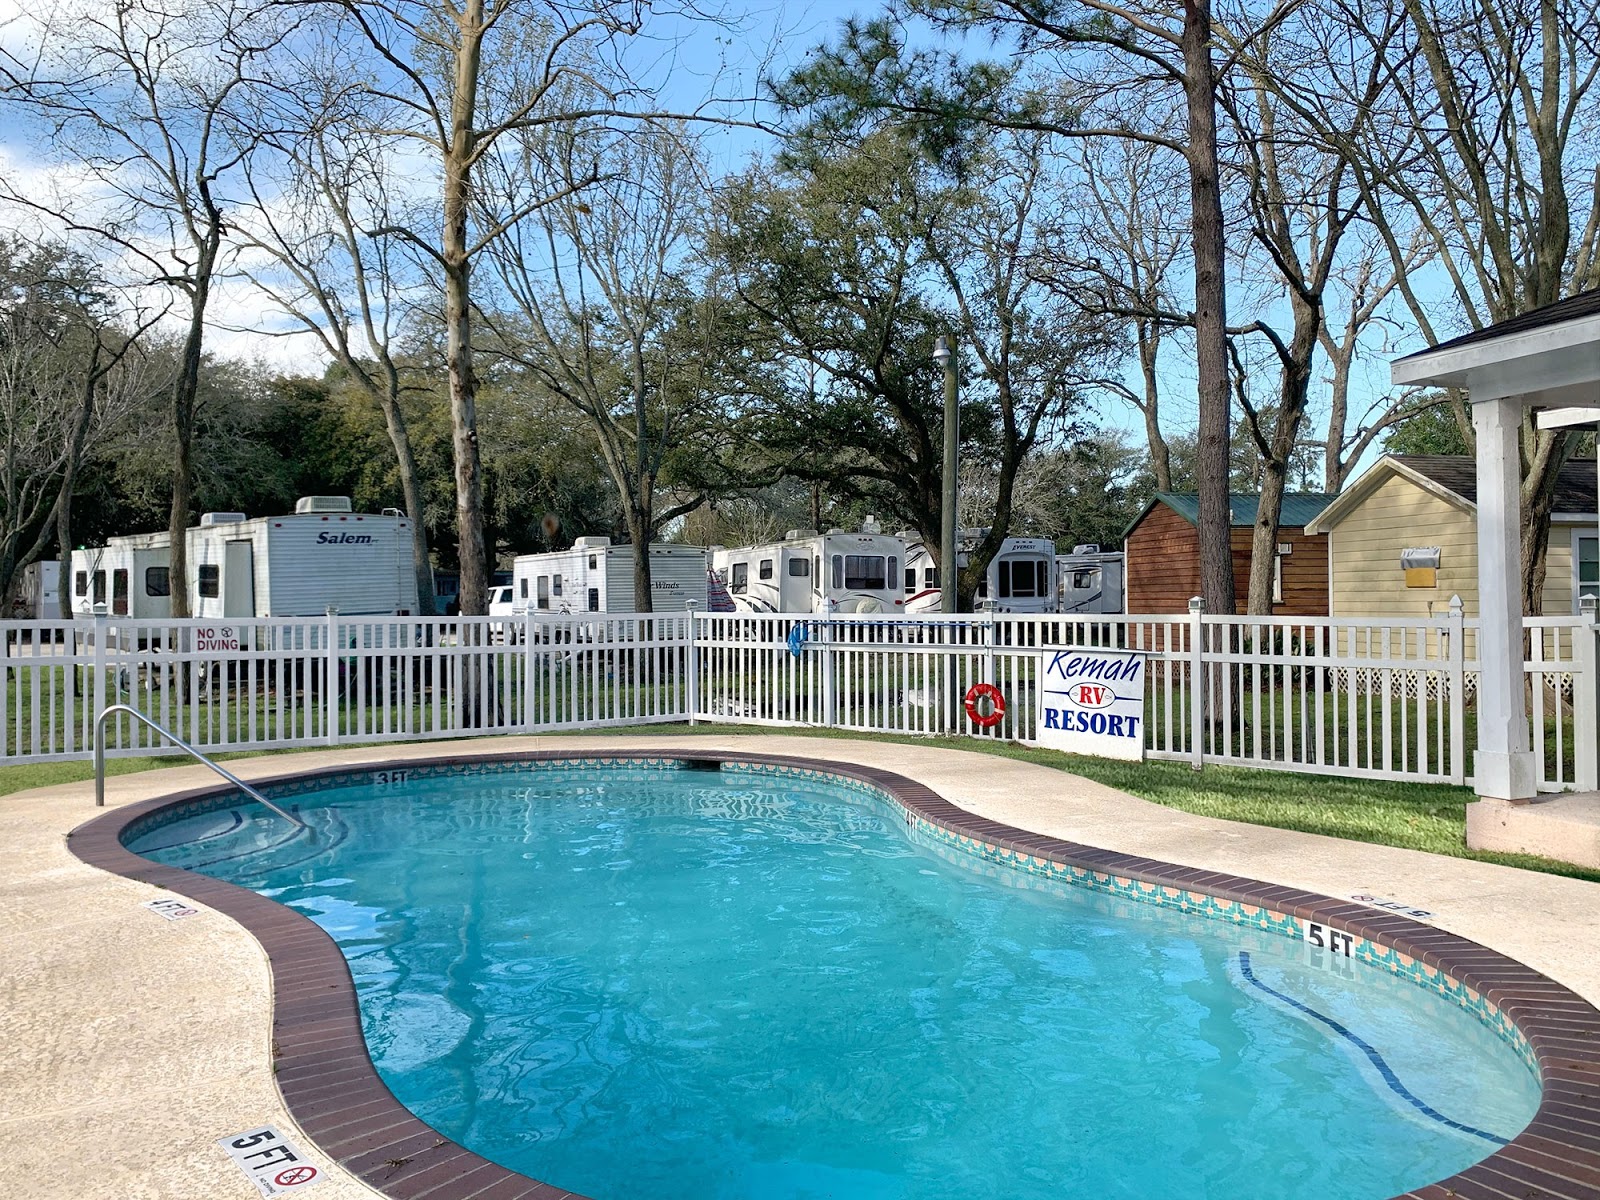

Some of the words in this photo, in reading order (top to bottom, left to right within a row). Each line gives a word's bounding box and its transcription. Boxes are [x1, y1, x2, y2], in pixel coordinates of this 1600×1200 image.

[316, 531, 371, 544] Salem
[654, 581, 681, 590] Winds
[197, 628, 215, 639] NO
[197, 639, 238, 651] DIVING
[1046, 650, 1142, 682] Kemah
[1079, 686, 1106, 705] RV
[1044, 707, 1140, 738] RESORT
[377, 772, 389, 785] 3
[392, 770, 407, 783] FT
[1308, 923, 1325, 948] 5
[1330, 929, 1354, 958] FT
[231, 1130, 276, 1149] 5
[243, 1144, 298, 1170] FT
